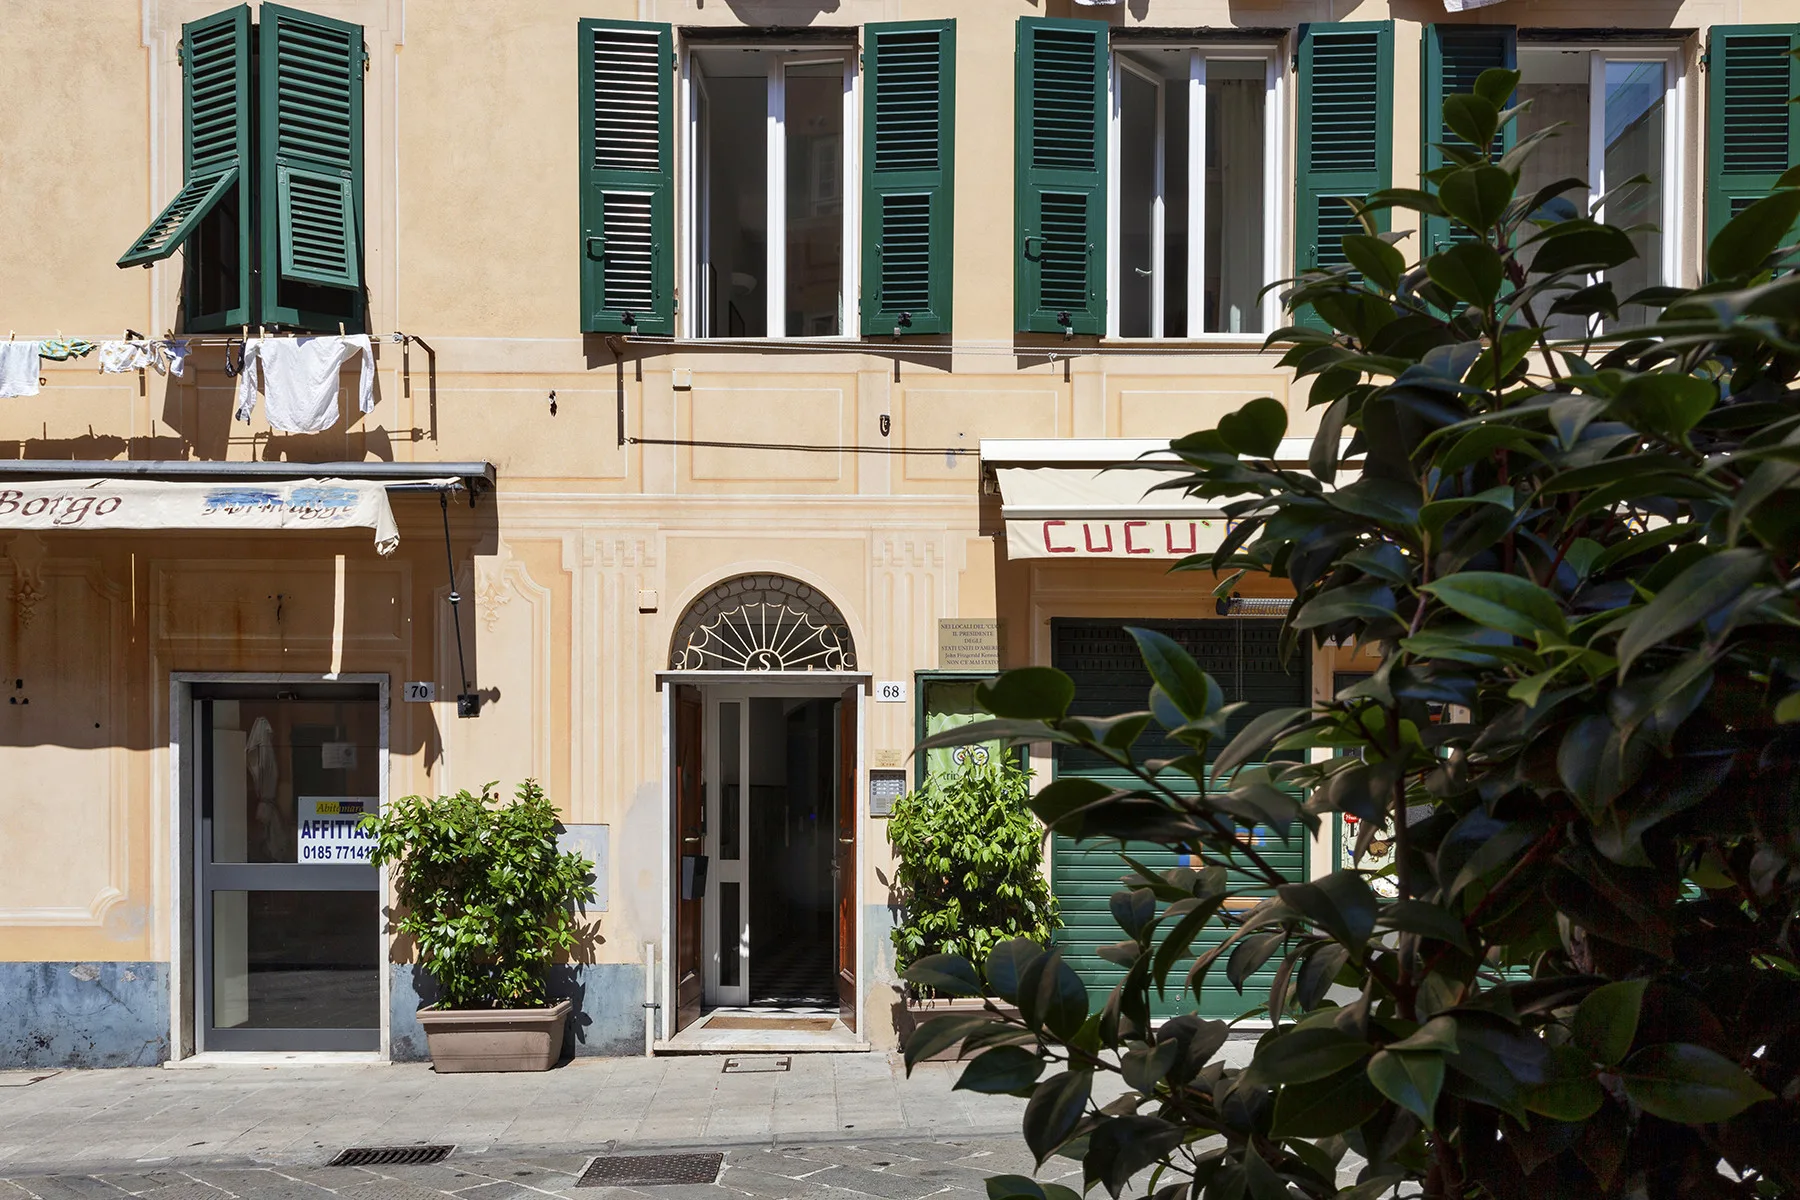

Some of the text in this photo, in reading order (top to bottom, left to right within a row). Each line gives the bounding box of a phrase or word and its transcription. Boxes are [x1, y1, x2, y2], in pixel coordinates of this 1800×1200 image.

[411, 685, 428, 698] 70
[883, 685, 900, 698] 68
[303, 845, 332, 859] 0185
